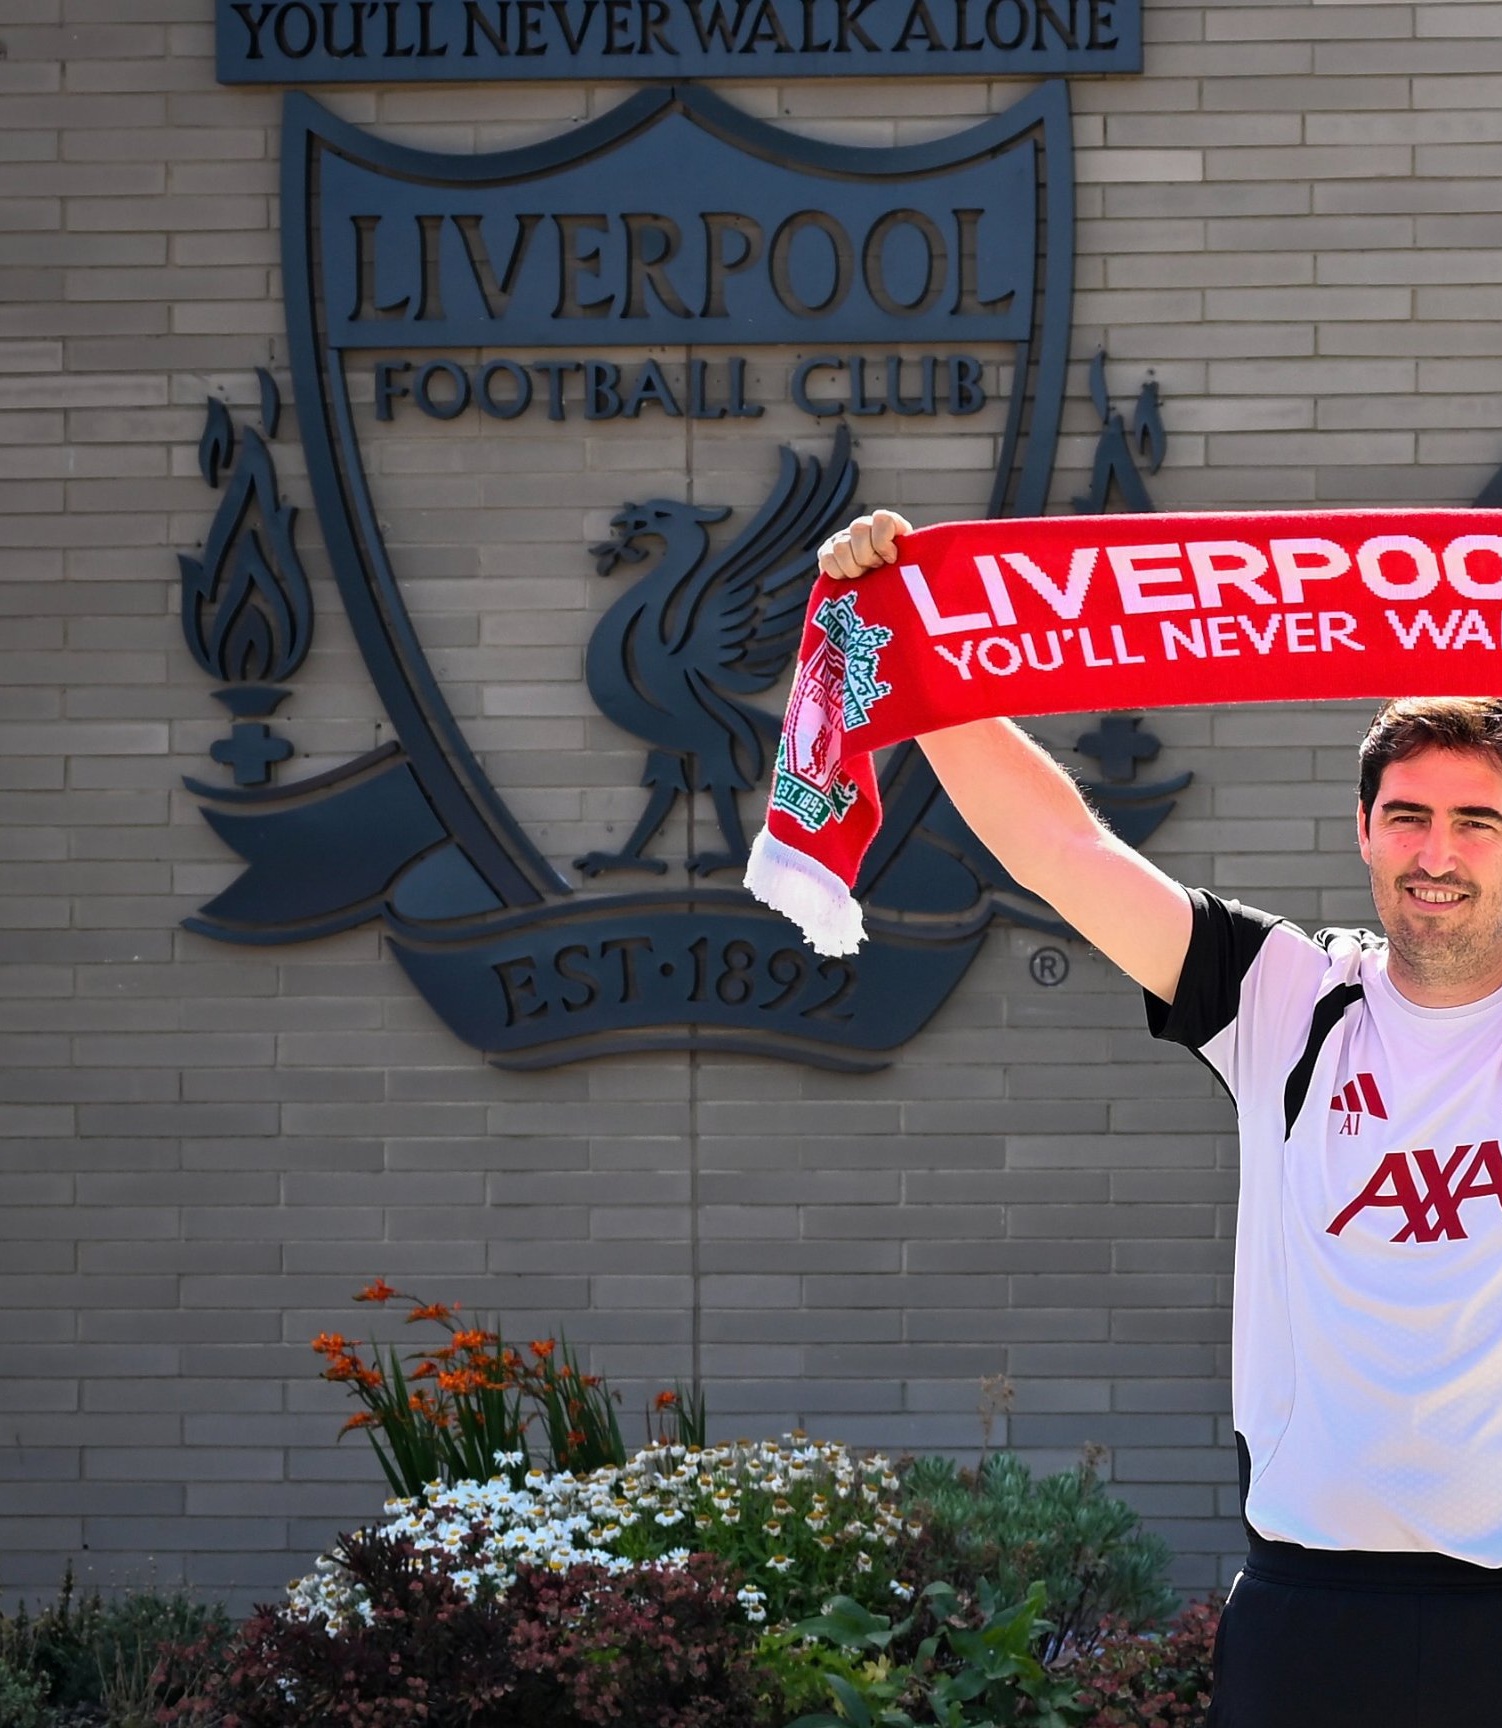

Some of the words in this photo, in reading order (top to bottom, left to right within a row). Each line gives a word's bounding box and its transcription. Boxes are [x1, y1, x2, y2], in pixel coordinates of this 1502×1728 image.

[231, 0, 448, 60] YOU'LL
[463, 0, 680, 56] NEVER
[687, 0, 882, 54] WALK
[891, 0, 1120, 51] ALONE
[348, 208, 1016, 321] LIVERPOOL
[374, 357, 765, 421] FOOTBALL
[791, 355, 986, 417] CLUB
[935, 626, 1144, 679] YOU'LL
[1161, 612, 1365, 659] NEVER
